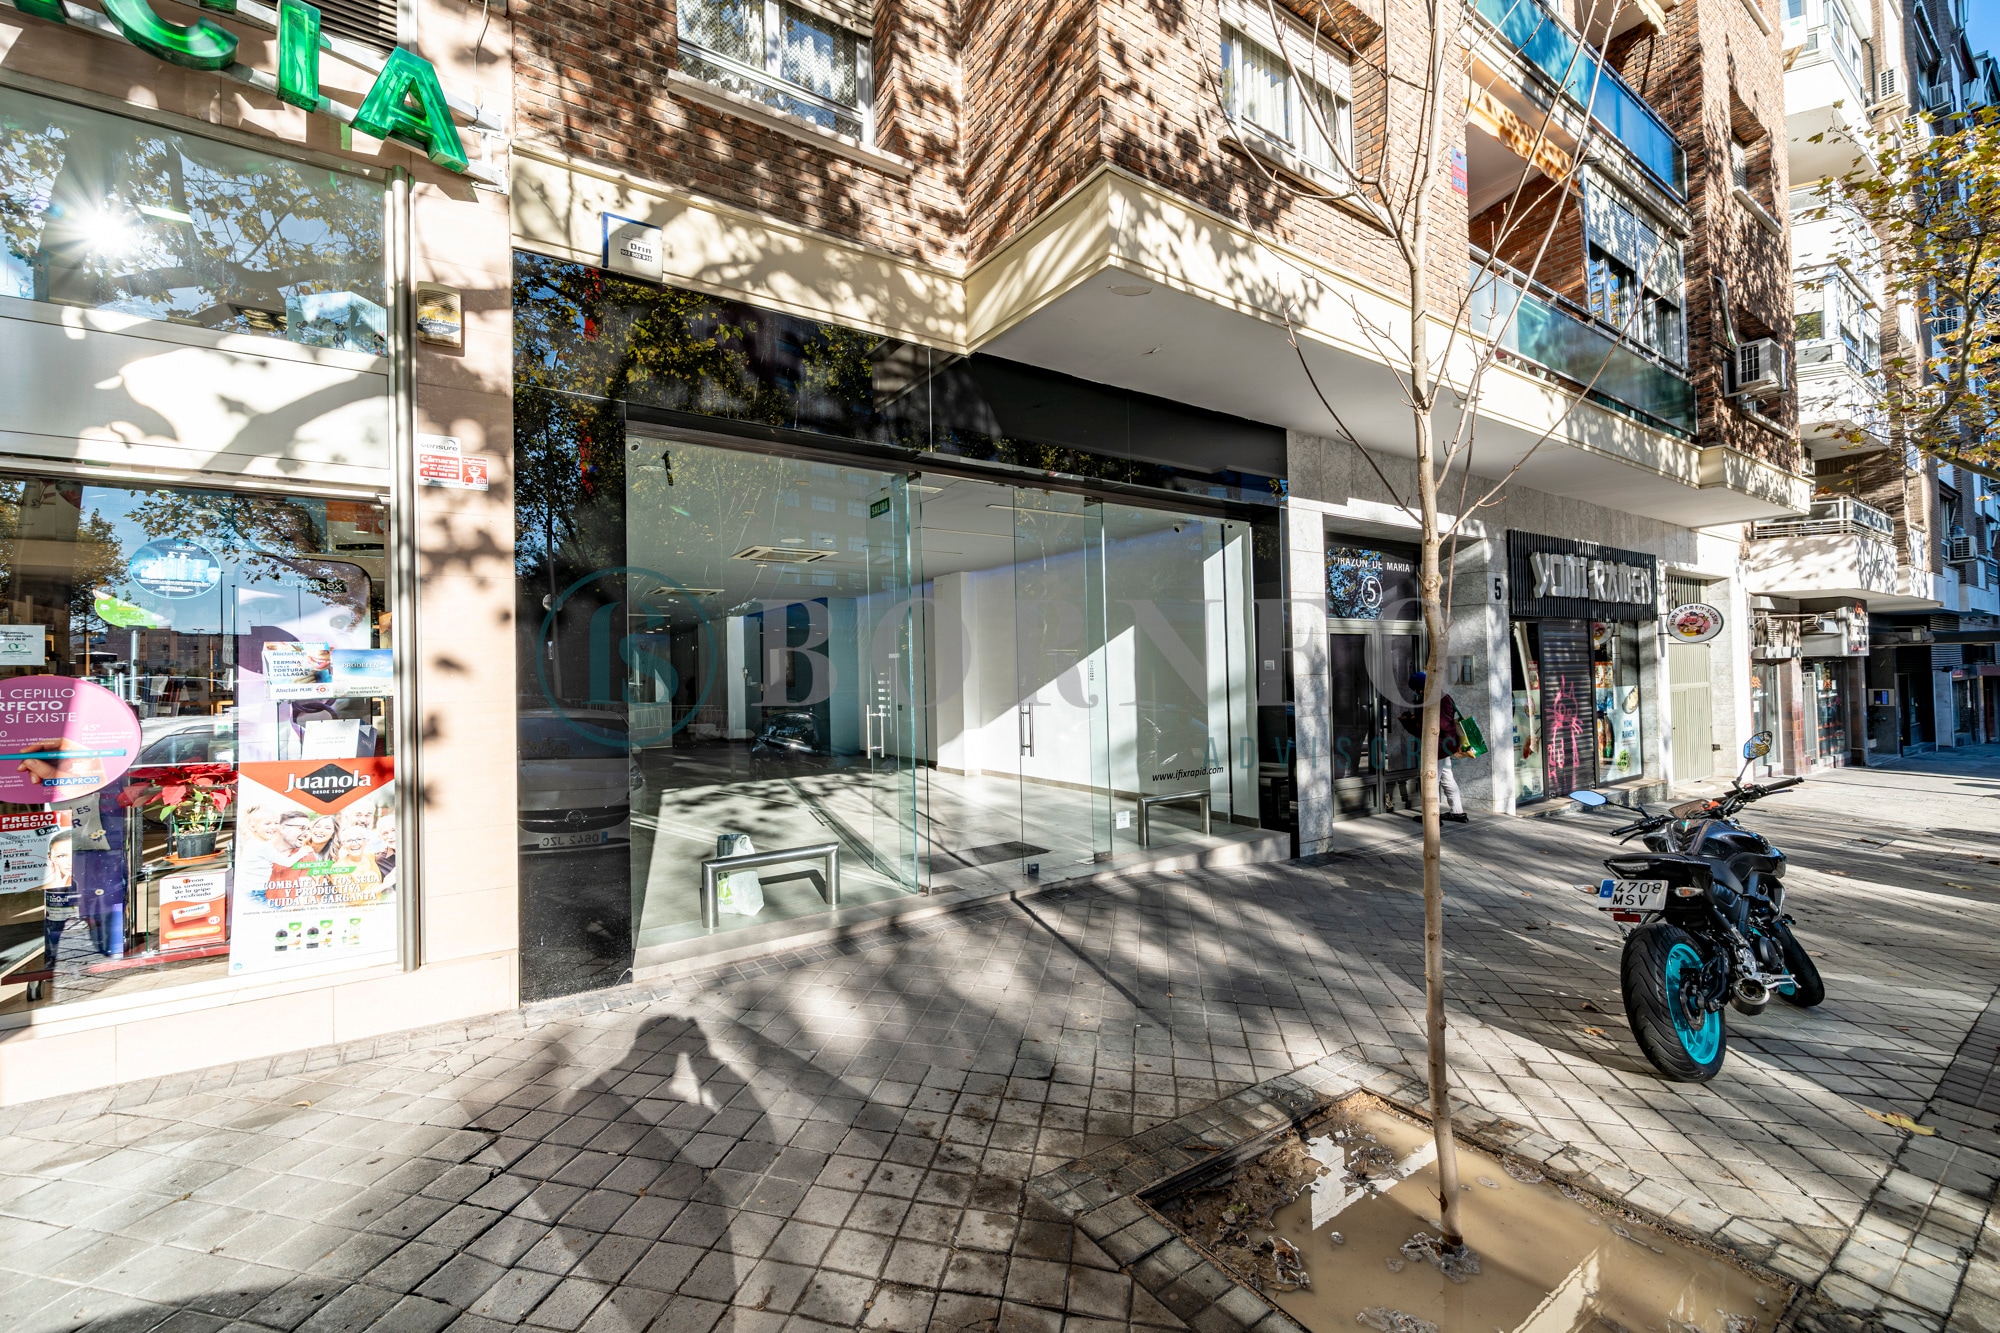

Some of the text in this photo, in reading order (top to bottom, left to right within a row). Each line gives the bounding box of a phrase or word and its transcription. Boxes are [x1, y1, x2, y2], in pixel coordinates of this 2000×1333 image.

[630, 243, 652, 254] Drin
[420, 443, 458, 451] verisure
[871, 500, 889, 516] SALIDA
[1372, 560, 1383, 570] DE
[1386, 562, 1410, 573] MARIA
[1530, 552, 1652, 605] YOMI RAMEN
[1366, 580, 1376, 603] 5
[1494, 578, 1502, 600] 5
[10, 688, 76, 699] CEPILLO
[5, 711, 77, 724] SÍ EXISTE
[1152, 766, 1224, 782] www.ifixrapid.com
[44, 777, 99, 786] CURAPROX
[284, 770, 371, 793] Juanola
[2, 813, 54, 824] PRECIO
[2, 821, 53, 830] ESPECIAL
[11, 862, 48, 871] RENUEVA
[3, 876, 39, 884] PROTEGE
[264, 874, 380, 890] COMBATE LA TOS SECA
[284, 884, 361, 898] Y PRODUCTIVA
[1615, 882, 1662, 894] 4708
[267, 893, 377, 909] CUIDA LA GARGANTA
[1612, 894, 1648, 906] MSV
